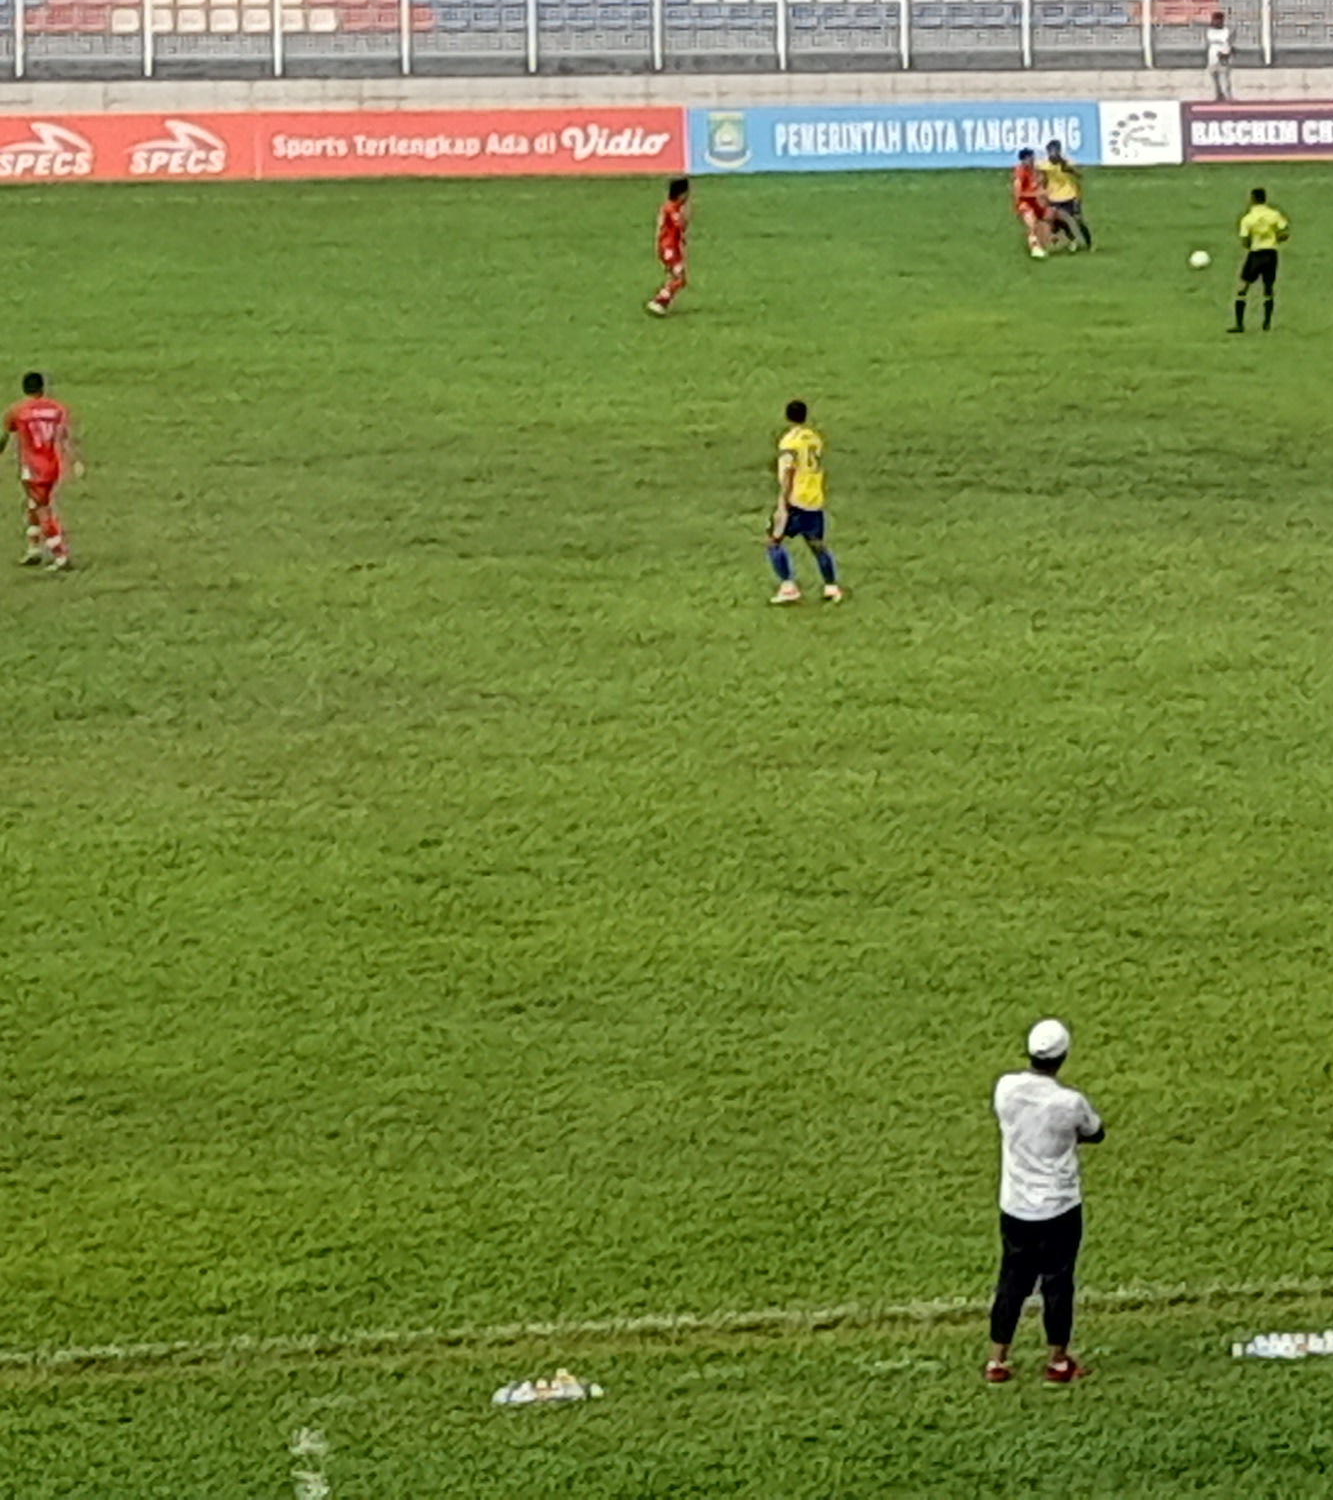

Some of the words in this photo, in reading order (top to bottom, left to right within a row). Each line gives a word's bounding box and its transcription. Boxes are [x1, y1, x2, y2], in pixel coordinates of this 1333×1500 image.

[272, 134, 348, 159] Sports
[353, 133, 481, 159] Terlengkap
[485, 132, 529, 155] Ada
[533, 132, 557, 154] di
[560, 123, 671, 161] Vidio
[774, 120, 901, 156] PEMERINTAH
[905, 119, 959, 154] KOTA
[961, 116, 1082, 151] TANGERANG
[0, 151, 92, 177] SPECS
[129, 150, 226, 174] SPECS
